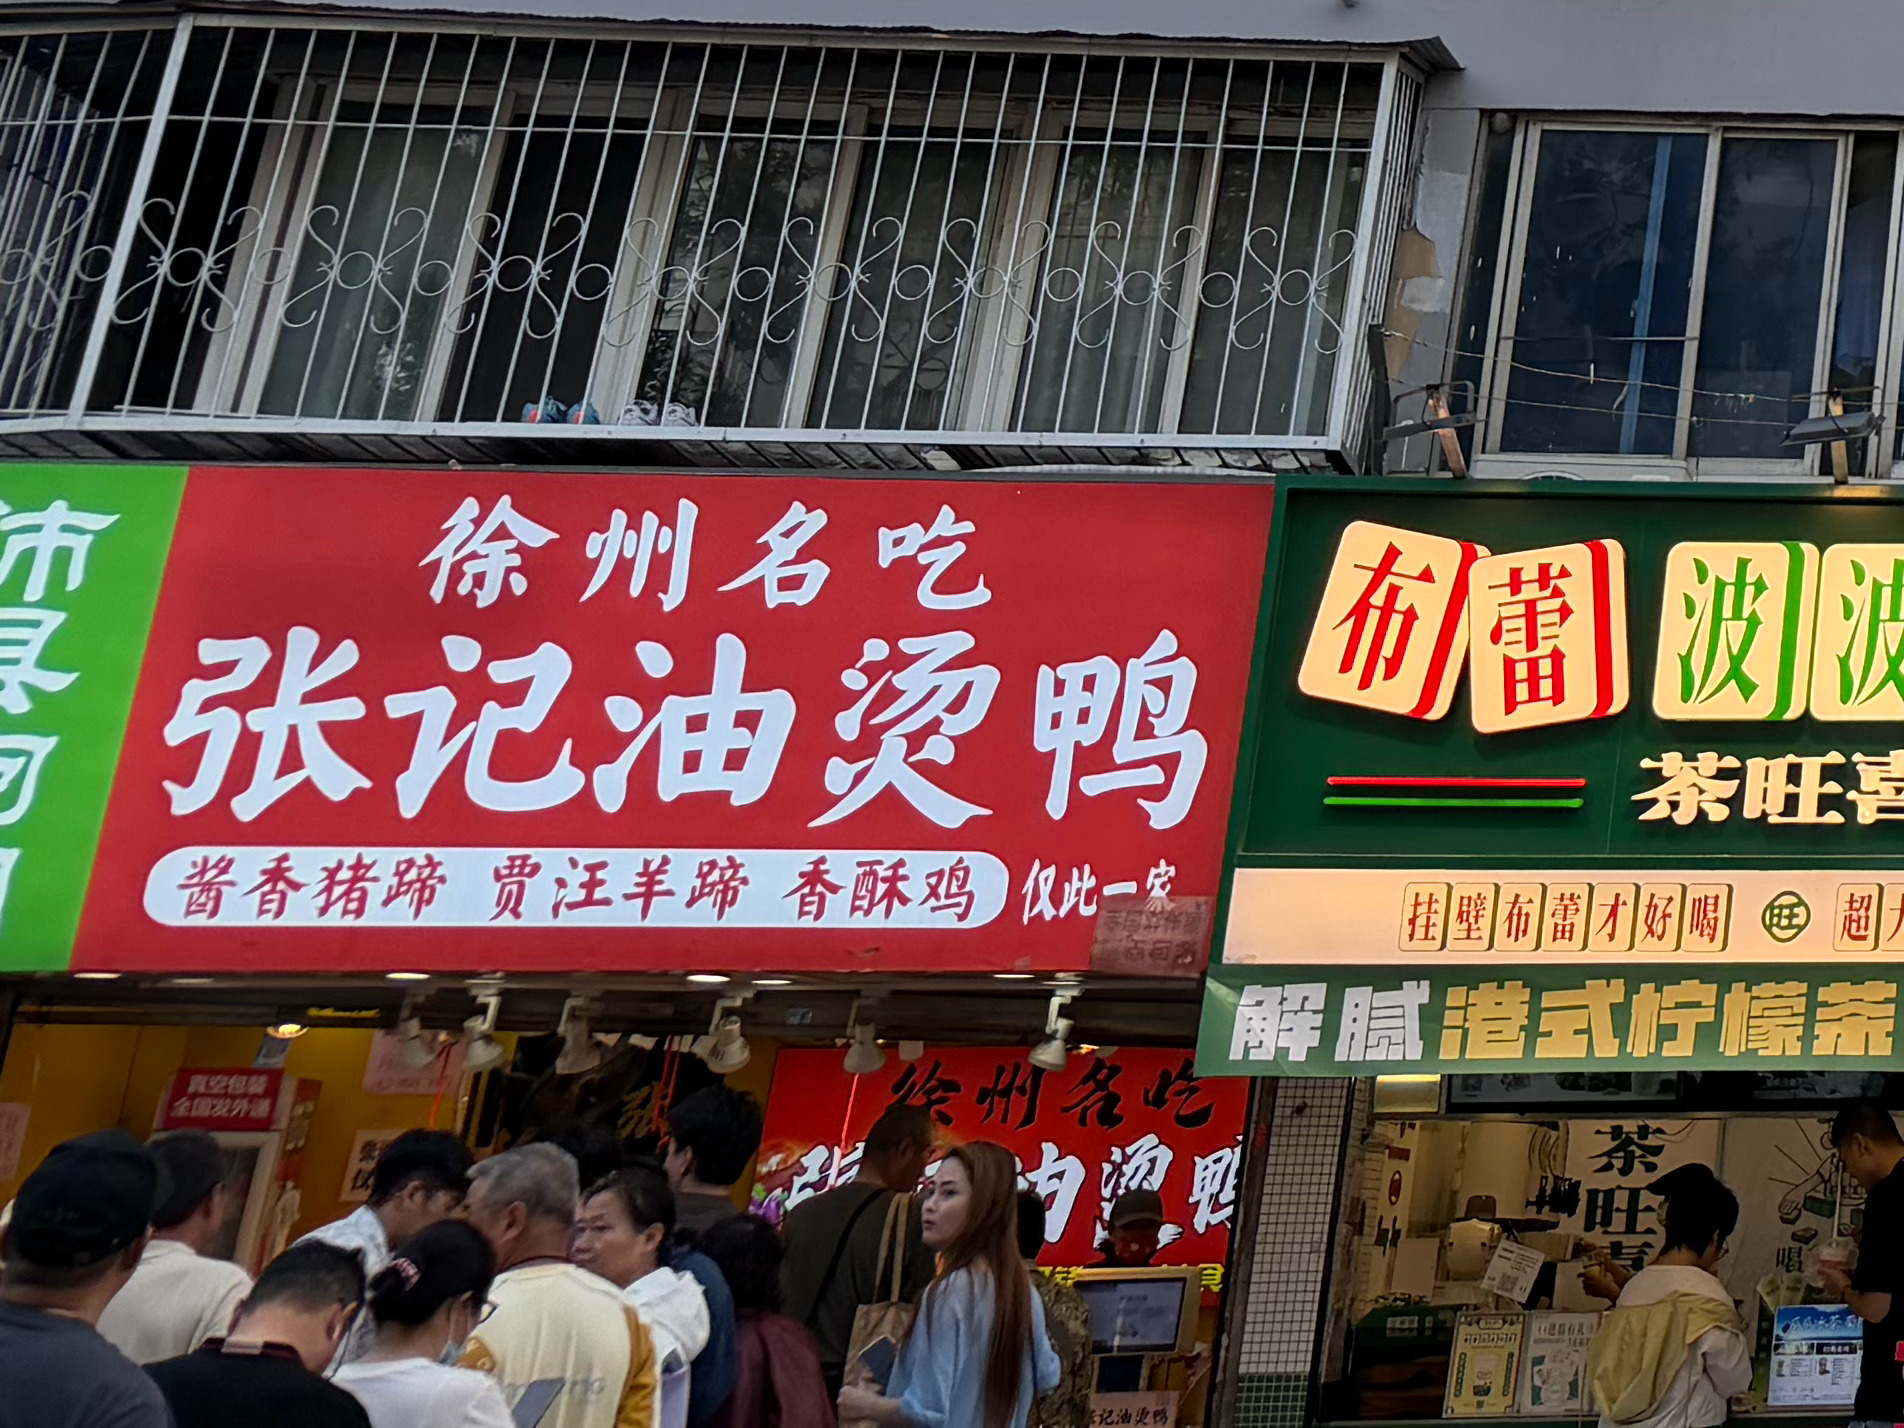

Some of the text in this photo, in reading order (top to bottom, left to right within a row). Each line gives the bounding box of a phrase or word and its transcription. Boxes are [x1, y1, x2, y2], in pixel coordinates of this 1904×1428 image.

[419, 493, 992, 611] 徐州名吃
[1333, 541, 1577, 716] 布蕾
[0, 499, 121, 934] 沛县
[162, 625, 1209, 831] 张记油烫鸭
[176, 855, 1177, 926] 酱香猪蹄 贾汪羊蹄 香酥鸡 仅此一家
[1406, 891, 1725, 947] 挂壁布蕾才好喝
[1768, 901, 1805, 935] 旺
[1228, 976, 1899, 1064] 解腻港式柠檬茶
[890, 1059, 1215, 1130] 徐州名吃
